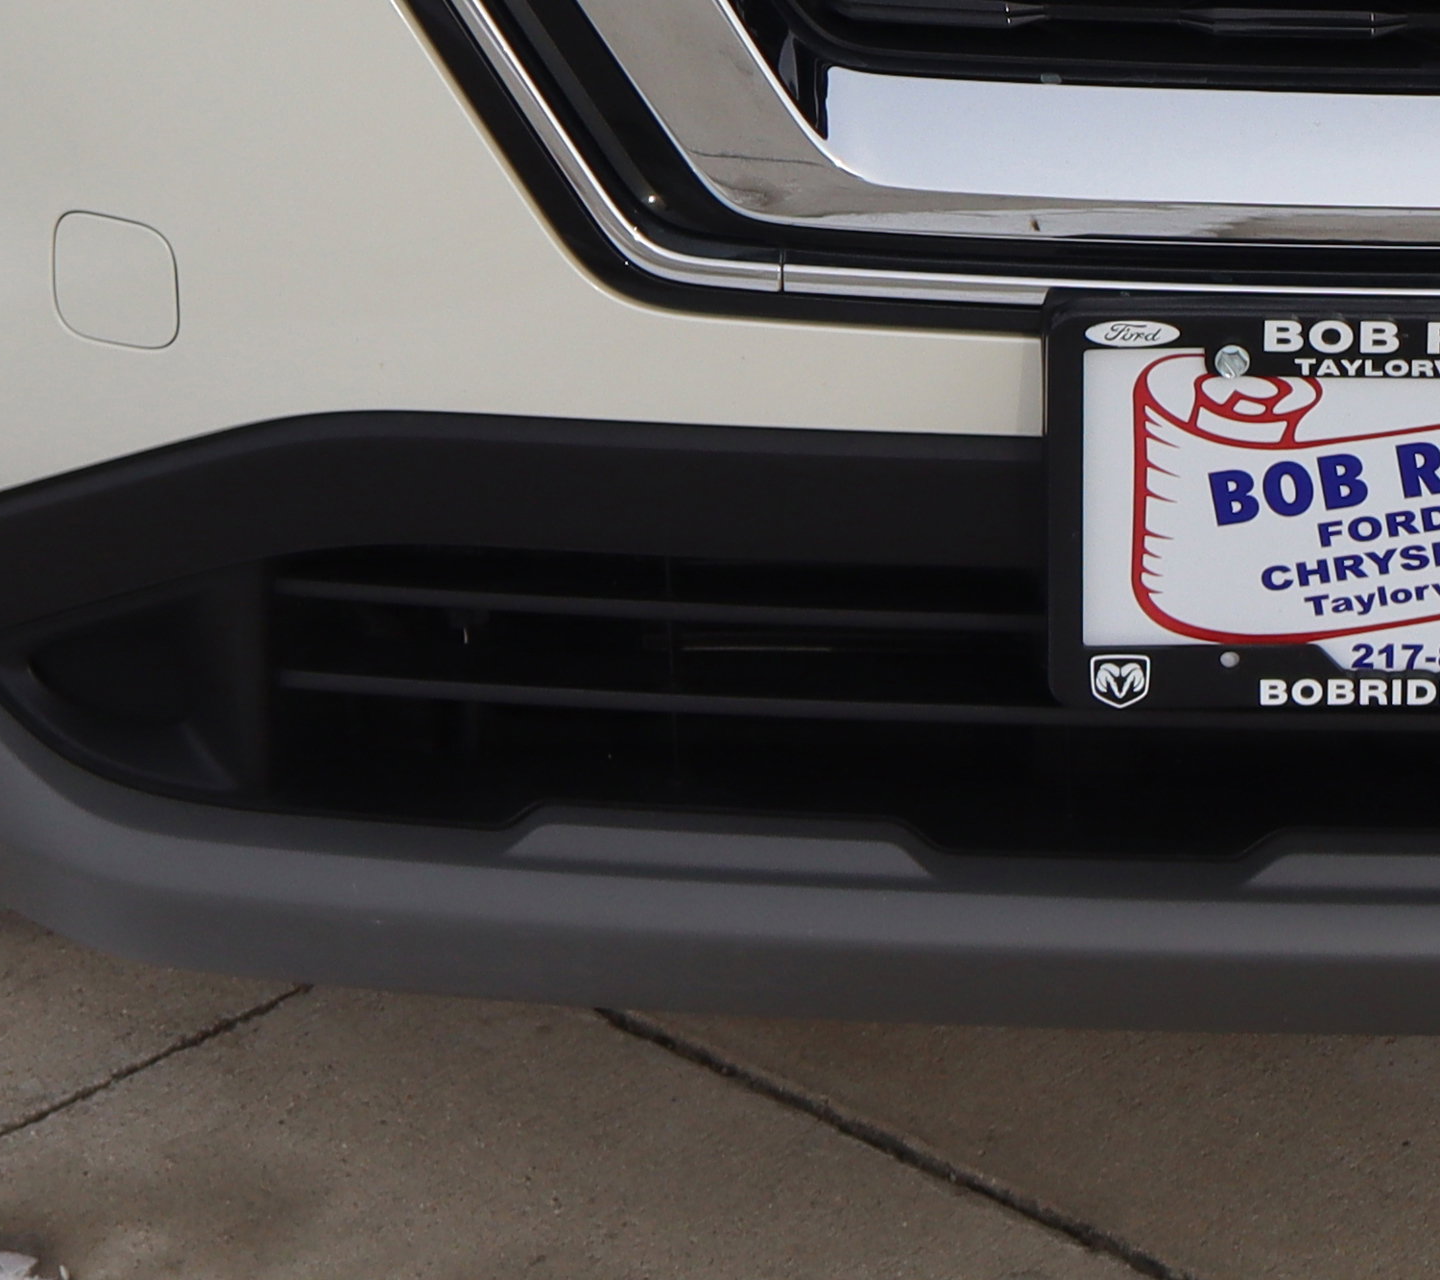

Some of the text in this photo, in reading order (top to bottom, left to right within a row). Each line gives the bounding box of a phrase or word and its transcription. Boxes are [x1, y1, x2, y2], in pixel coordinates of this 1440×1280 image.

[1103, 321, 1162, 342] Ford
[1263, 320, 1401, 354] BOB
[1208, 452, 1369, 526] BOB
